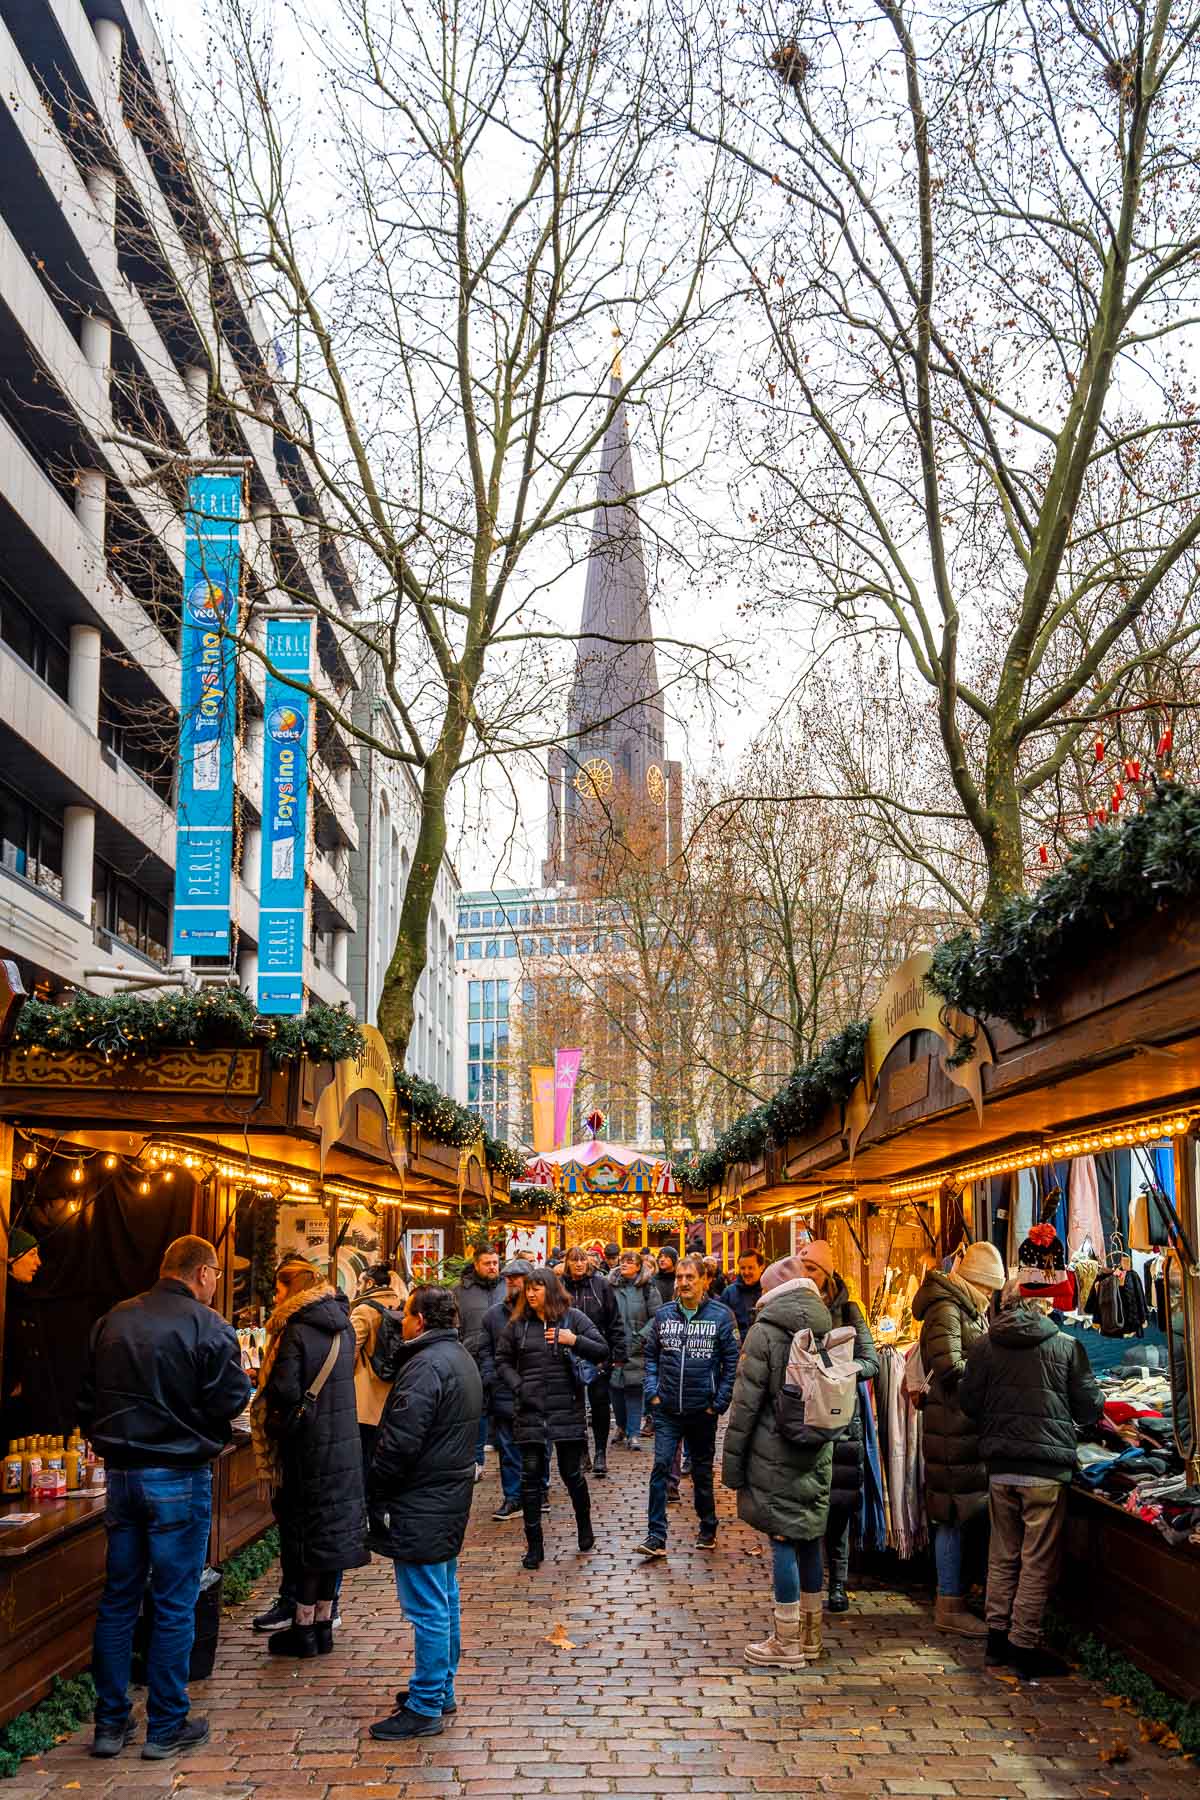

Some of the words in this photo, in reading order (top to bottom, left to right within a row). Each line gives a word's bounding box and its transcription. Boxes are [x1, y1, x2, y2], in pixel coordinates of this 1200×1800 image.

[190, 494, 239, 513] PERLE
[268, 634, 308, 652] PERLE
[196, 632, 225, 731] Toysino
[274, 750, 297, 831] Toysino
[188, 839, 213, 895] PERLE
[213, 839, 222, 895] HAMBURG
[268, 919, 289, 965] PERLE
[659, 1322, 684, 1335] CAMP
[687, 1323, 716, 1336] DAVID
